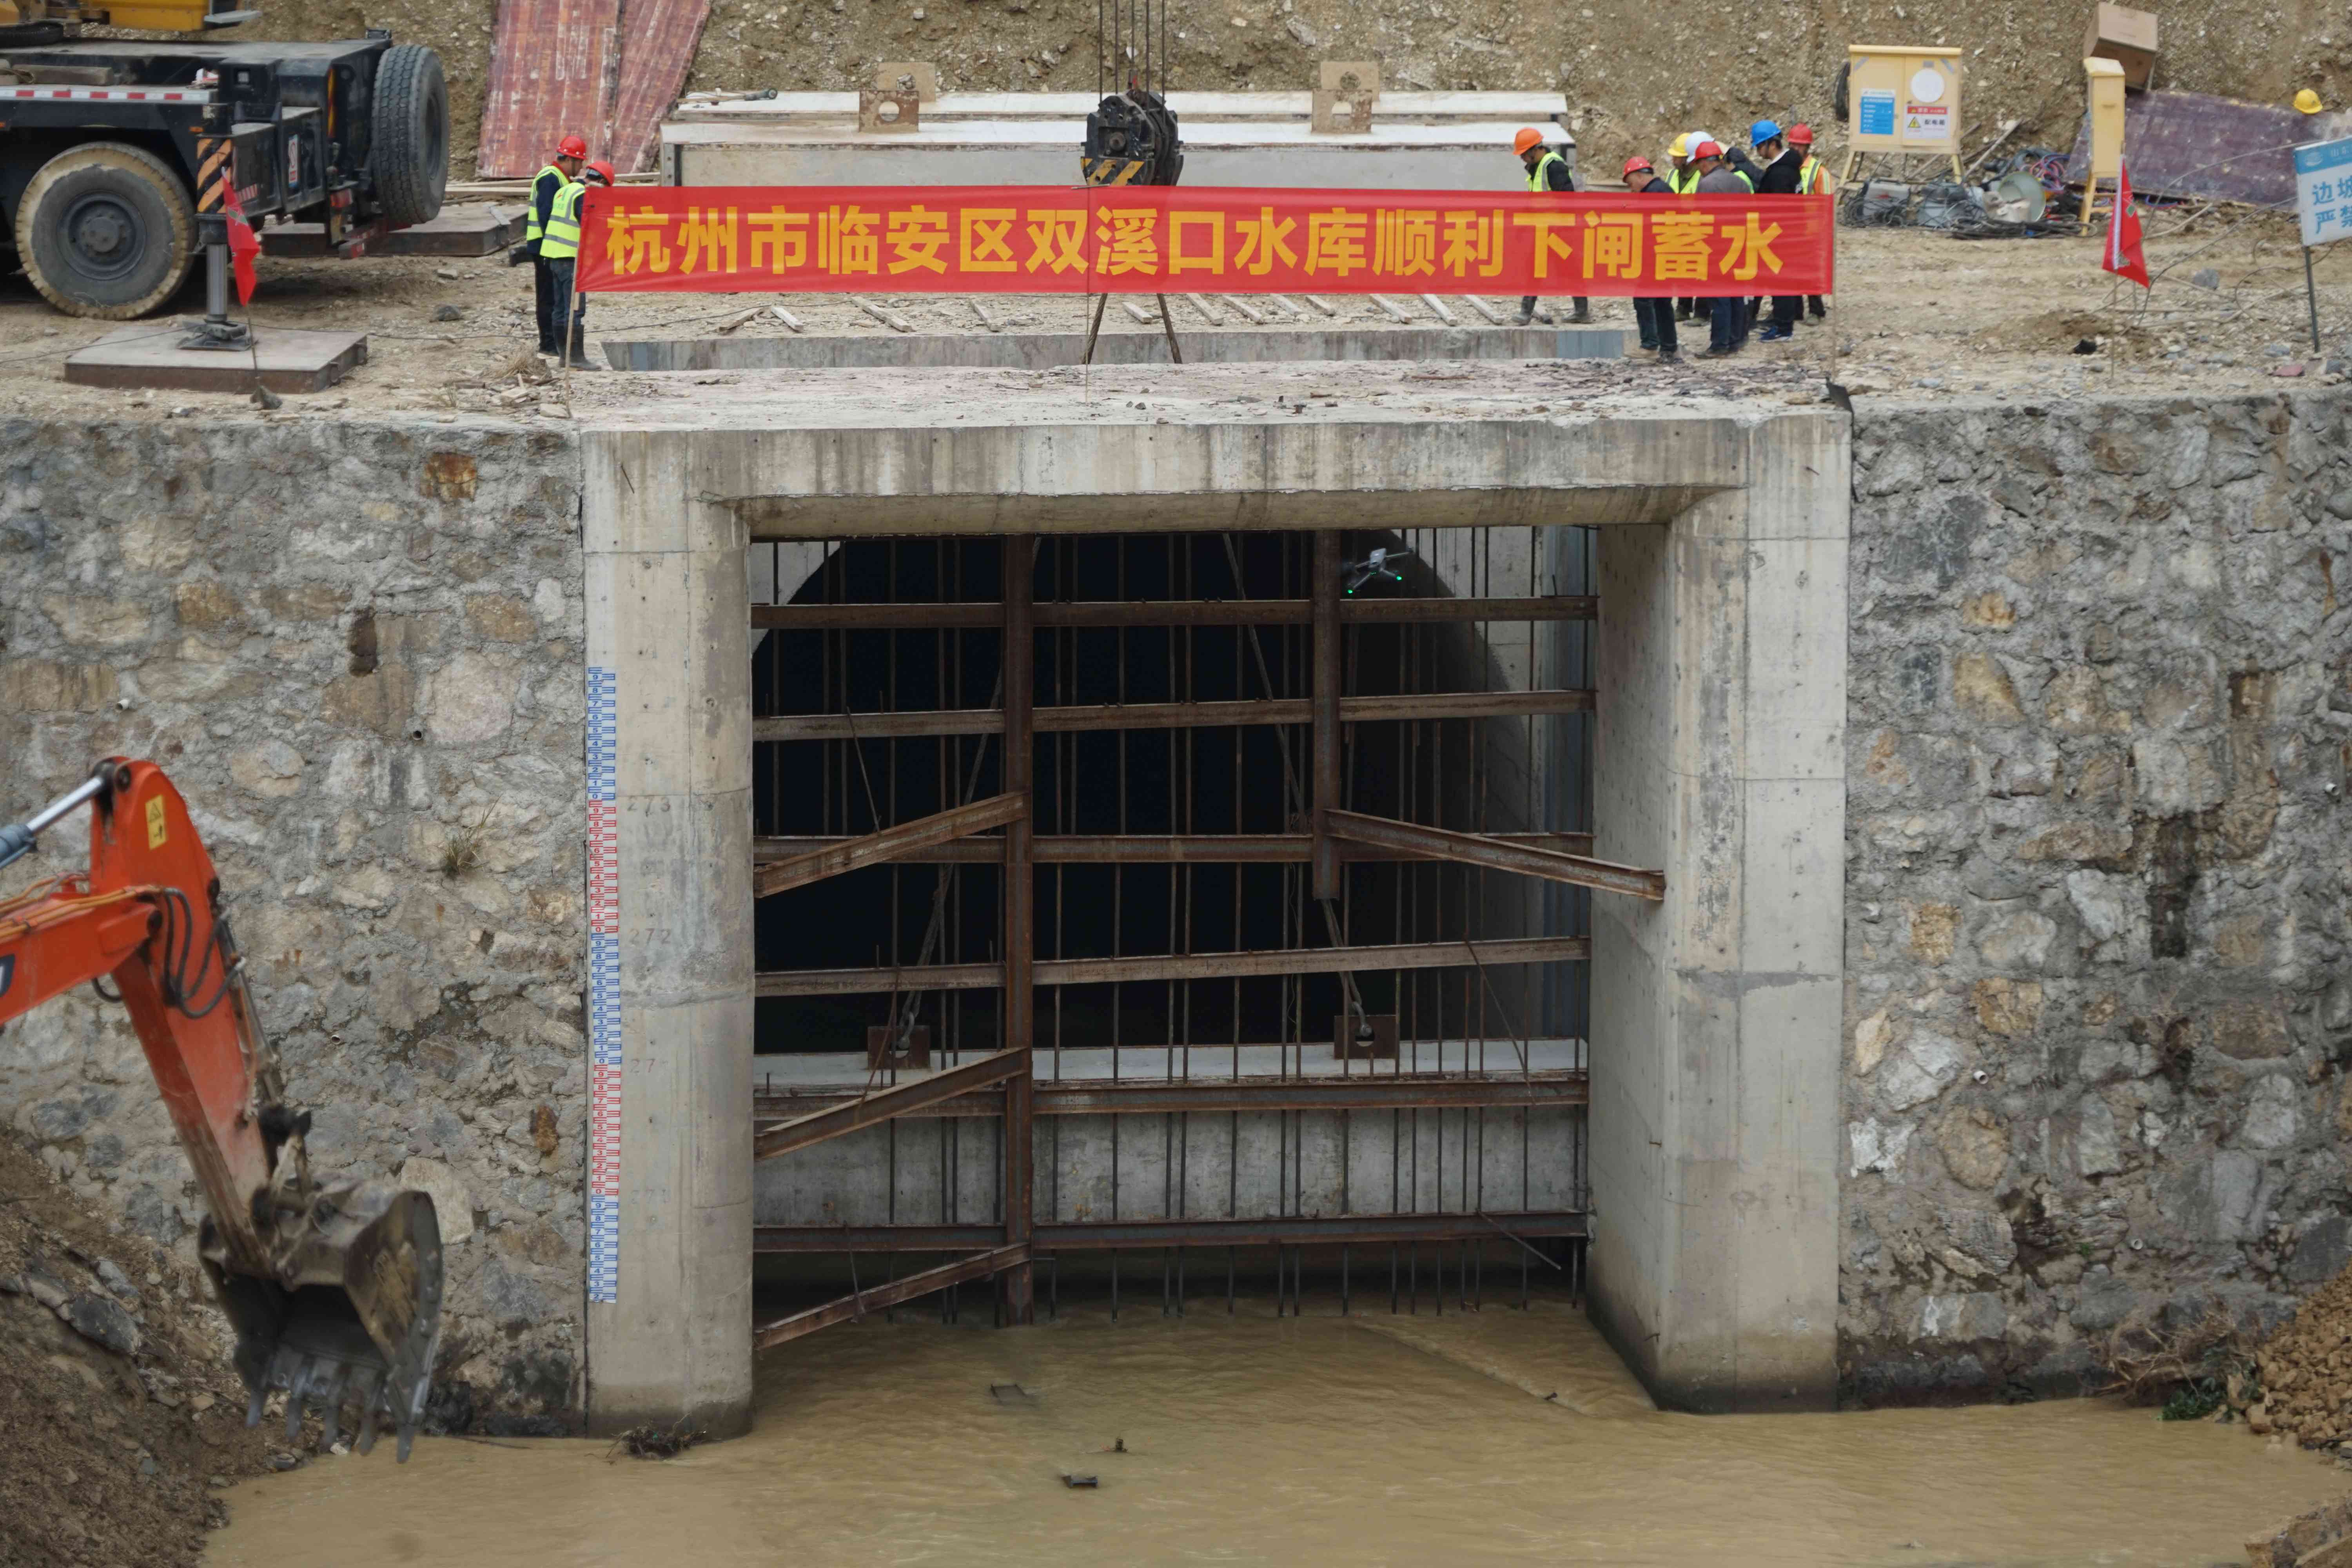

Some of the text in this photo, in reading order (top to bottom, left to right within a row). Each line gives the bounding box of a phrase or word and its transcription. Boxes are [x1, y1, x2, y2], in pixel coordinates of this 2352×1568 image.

[606, 203, 1784, 281] 杭州市临安区双溪口水库顺利下闸蓄水
[629, 928, 671, 945] 272
